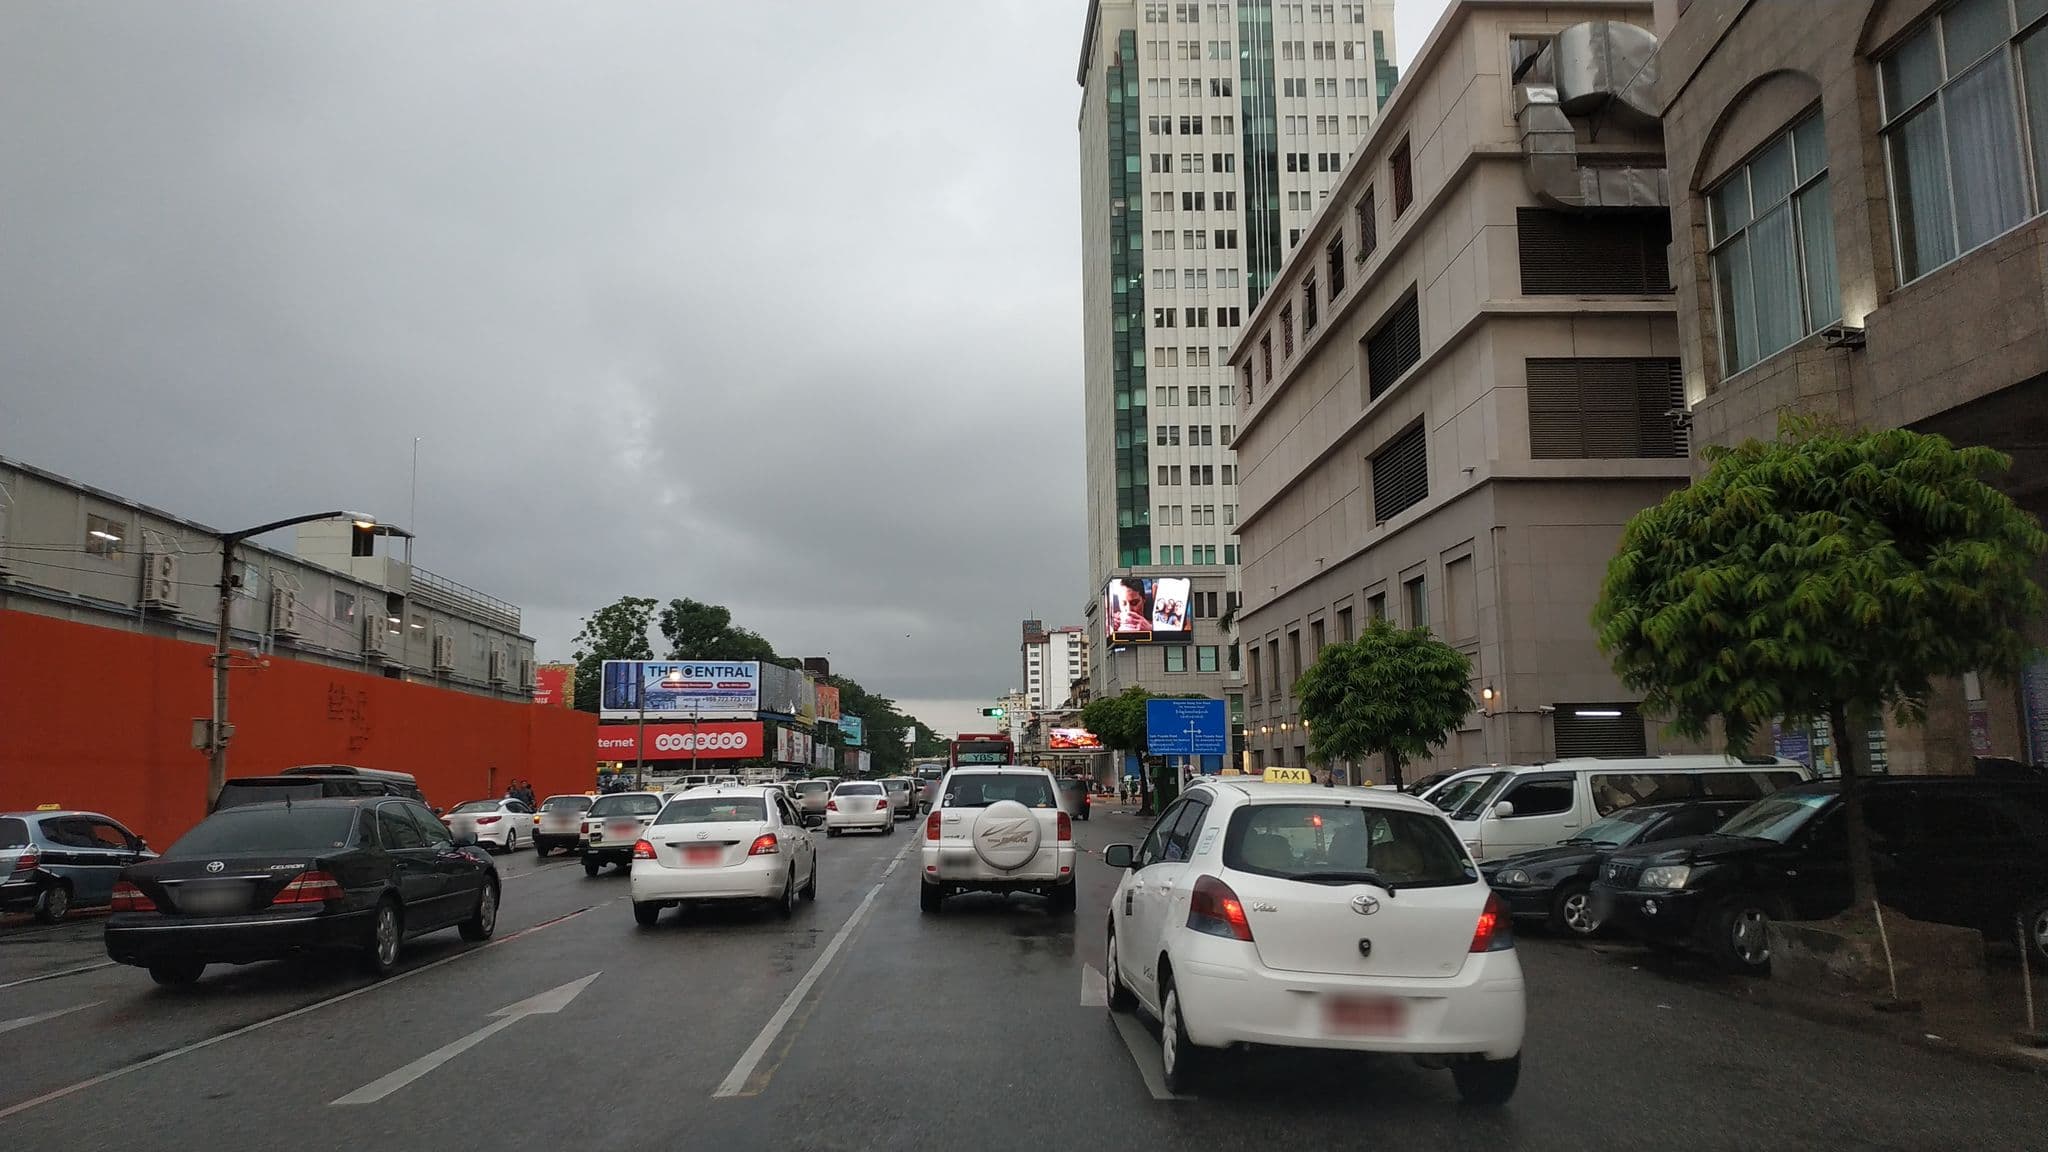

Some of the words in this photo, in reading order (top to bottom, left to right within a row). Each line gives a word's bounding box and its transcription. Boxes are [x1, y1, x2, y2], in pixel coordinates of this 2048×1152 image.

[682, 665, 752, 678] CENTRAL
[657, 732, 746, 750] ooredoo
[1271, 769, 1305, 780] TAXI
